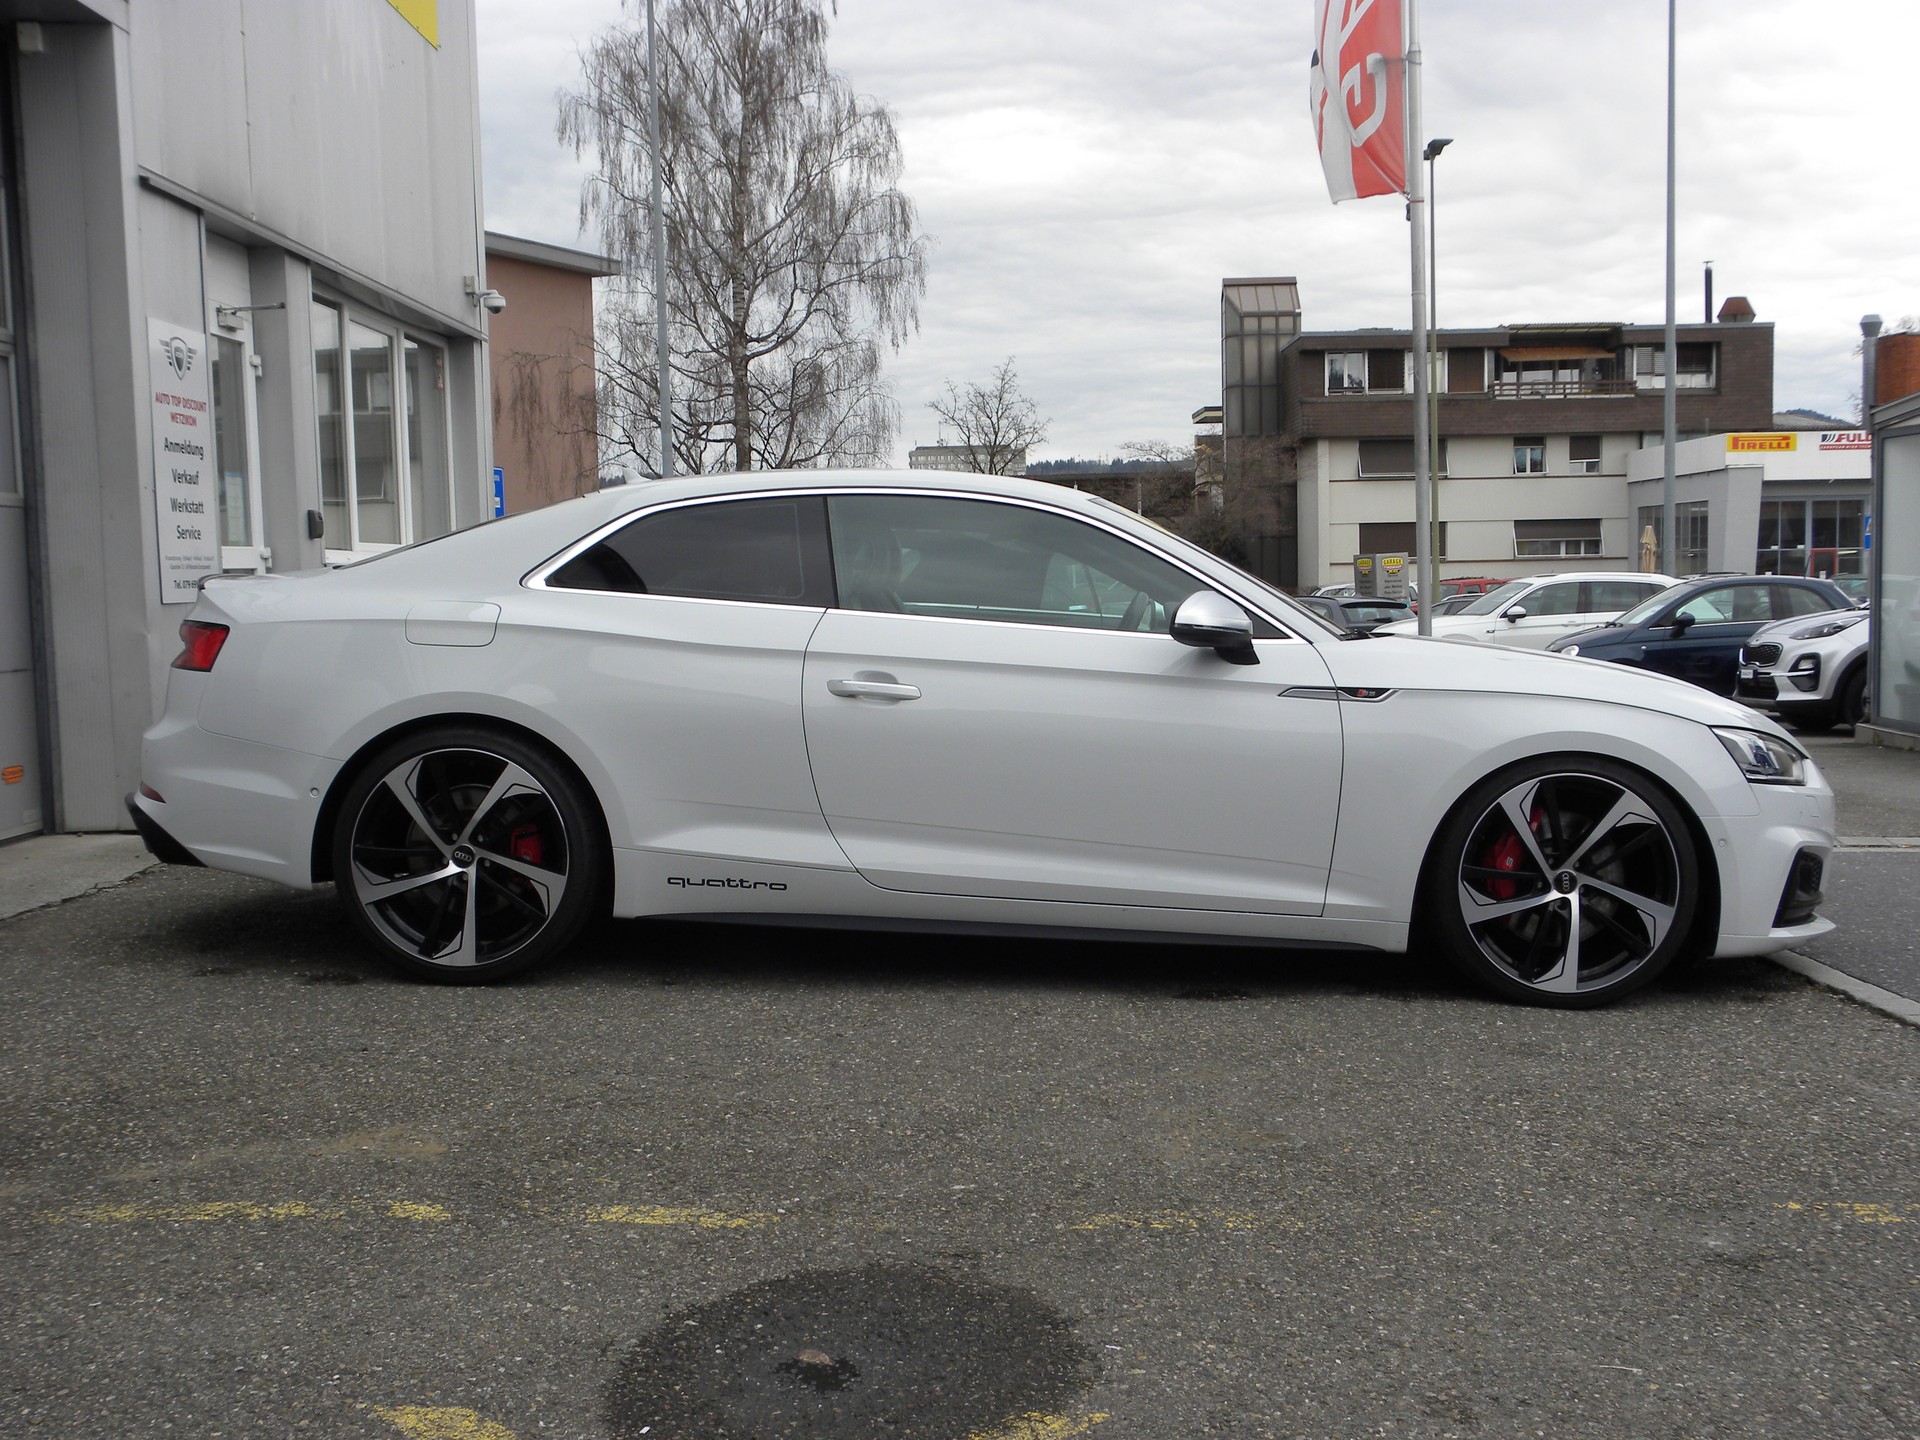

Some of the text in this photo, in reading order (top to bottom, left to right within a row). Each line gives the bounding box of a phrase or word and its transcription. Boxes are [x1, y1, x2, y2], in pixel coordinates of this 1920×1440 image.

[155, 391, 207, 412] AUTO TOP DISCOUNT
[170, 412, 197, 427] WETZIKON
[164, 437, 204, 460] Anmeldung
[1732, 435, 1791, 450] PIRELLI
[171, 468, 200, 485] Verkauf
[170, 497, 204, 514] Werkstatt
[176, 525, 202, 541] Service
[667, 876, 788, 891] quattro
